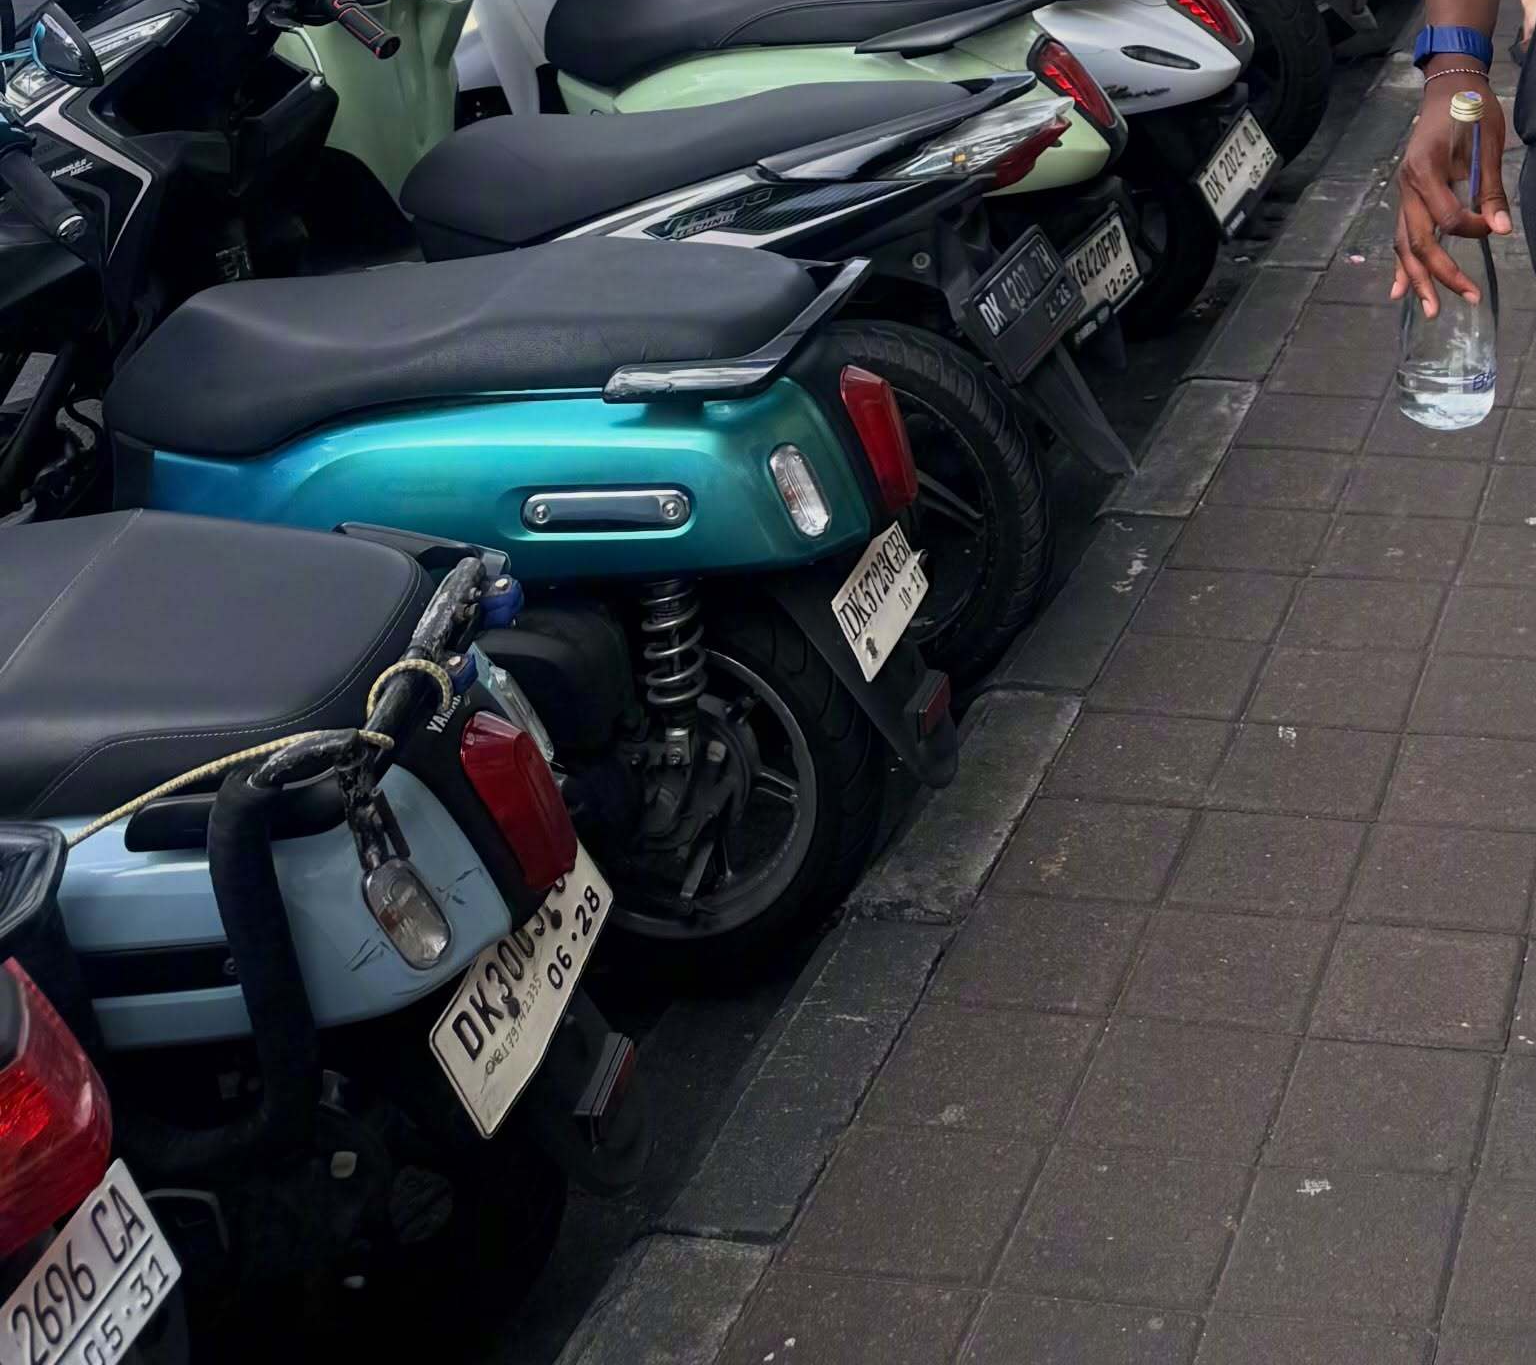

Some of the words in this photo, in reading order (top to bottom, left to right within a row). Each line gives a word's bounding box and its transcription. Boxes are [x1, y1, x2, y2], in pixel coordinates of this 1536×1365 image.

[1204, 172, 1226, 204] DK
[978, 292, 1008, 337] DK
[11, 1239, 97, 1365] 2696
[90, 1183, 146, 1264] CA
